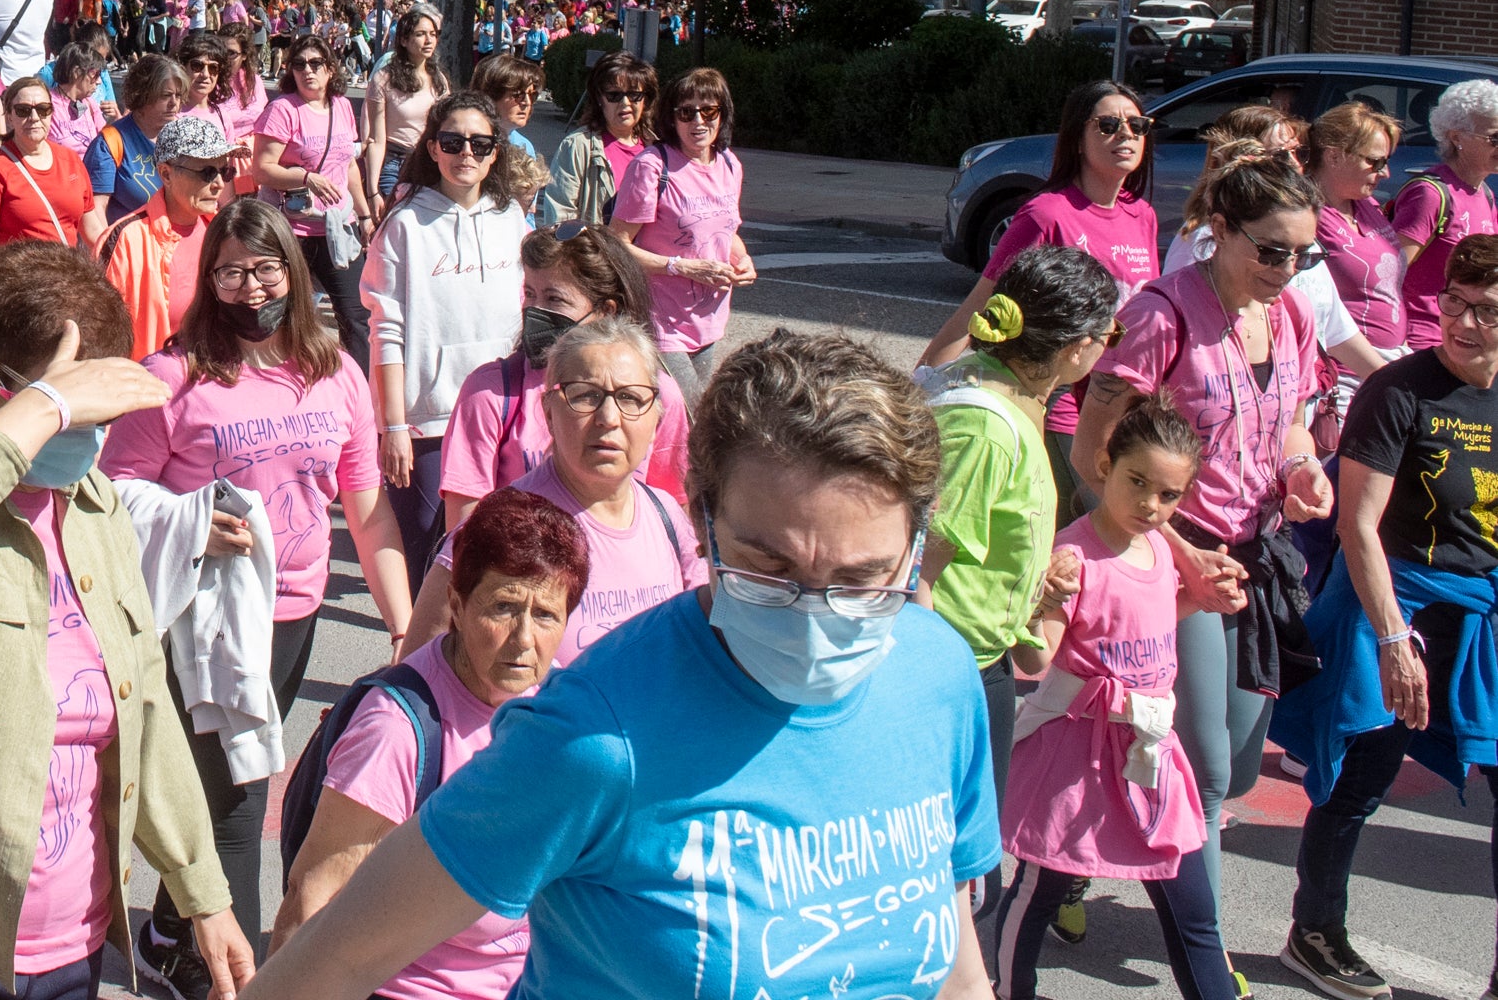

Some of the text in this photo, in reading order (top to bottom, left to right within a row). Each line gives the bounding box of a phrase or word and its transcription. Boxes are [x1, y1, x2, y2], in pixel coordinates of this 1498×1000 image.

[212, 417, 278, 459] MARCHA
[283, 411, 339, 439] MUJERES
[1446, 417, 1482, 432] Marcha
[1483, 423, 1492, 433] de
[1453, 430, 1492, 445] Mujeres
[213, 439, 339, 480] SEGOVIA
[581, 589, 632, 623] MARCHA
[1098, 637, 1160, 673] MARCHA
[755, 815, 879, 910] MARCHA
[912, 893, 959, 985] 20
